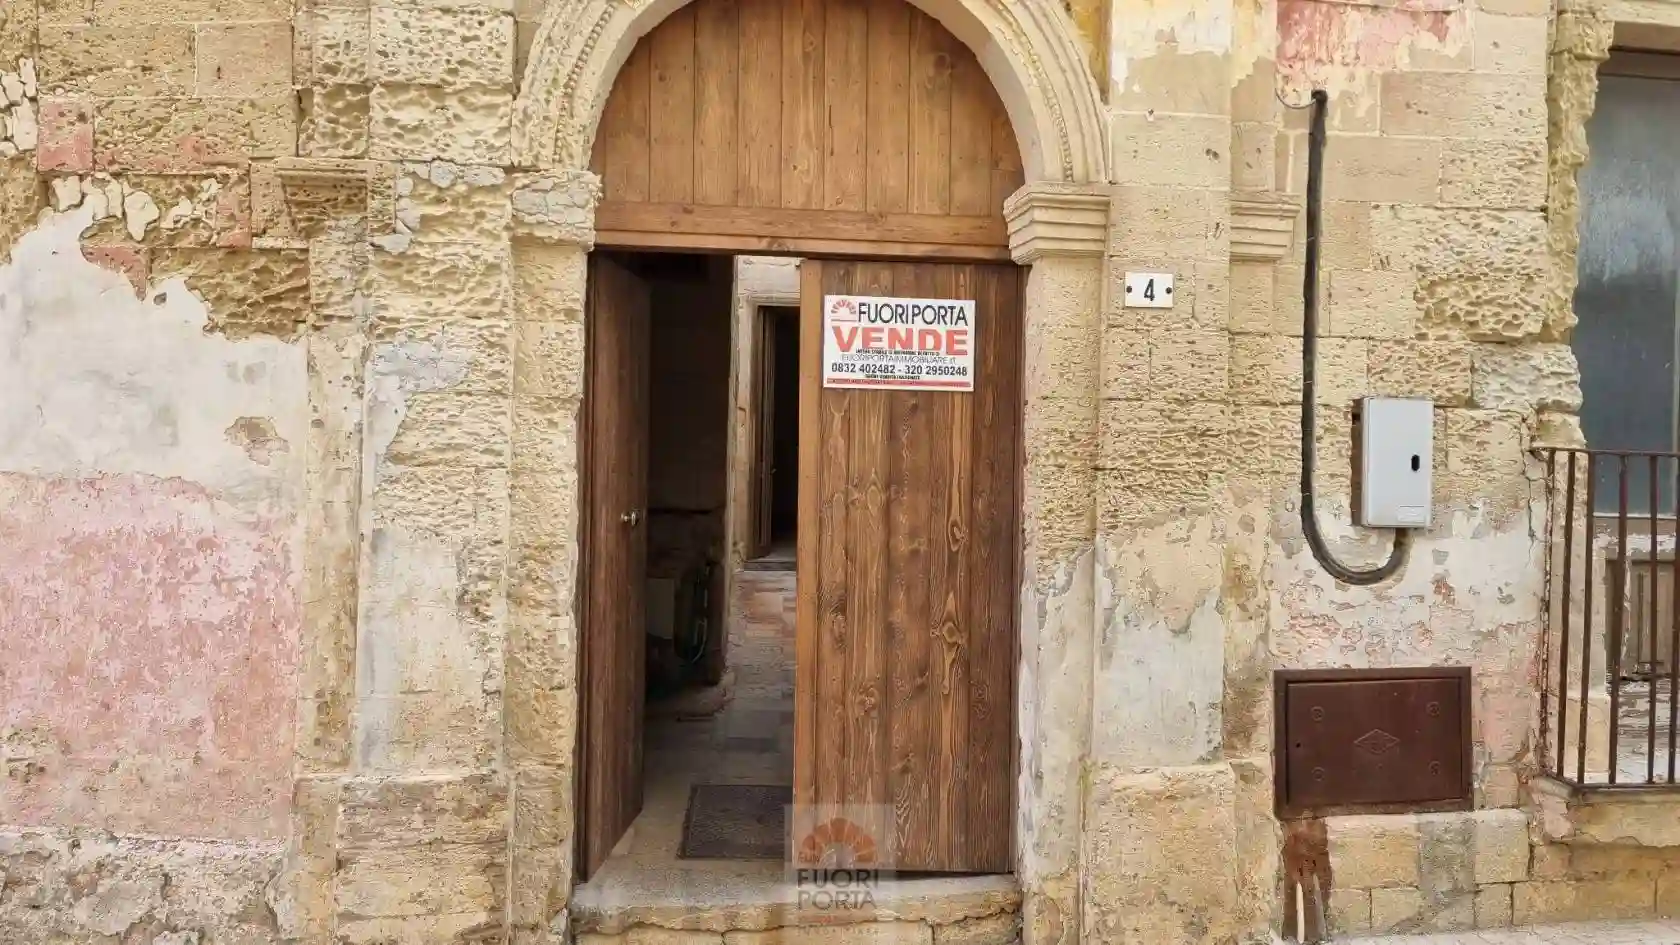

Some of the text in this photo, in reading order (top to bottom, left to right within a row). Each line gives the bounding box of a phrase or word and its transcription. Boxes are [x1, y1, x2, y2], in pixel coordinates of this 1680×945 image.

[1144, 278, 1155, 302] 4
[832, 326, 968, 356] VENDE
[831, 363, 857, 374] 0832
[859, 364, 896, 375] 402482
[905, 365, 923, 375] 320
[925, 366, 968, 377] 2950248
